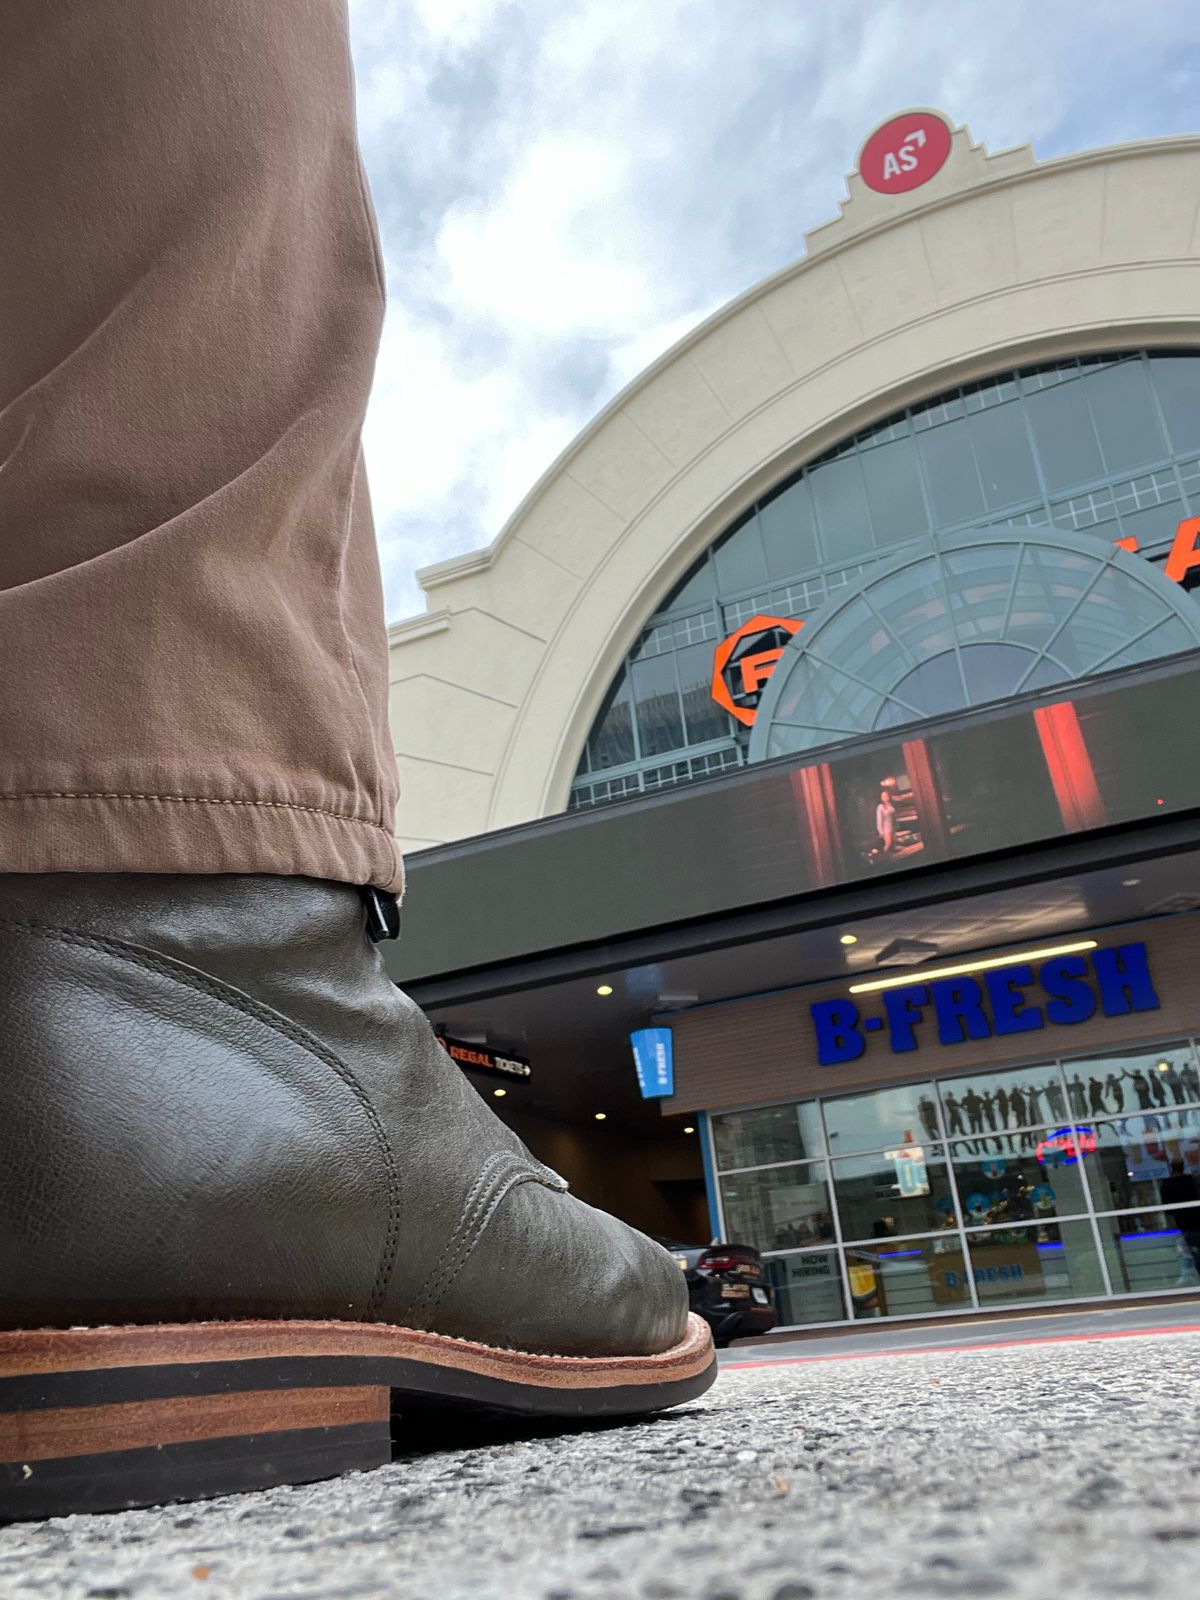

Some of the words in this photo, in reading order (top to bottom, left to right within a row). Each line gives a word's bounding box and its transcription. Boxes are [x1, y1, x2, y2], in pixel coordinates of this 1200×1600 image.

[883, 145, 918, 180] AS
[810, 942, 1161, 1066] B-FRESH
[450, 1046, 493, 1068] REGAL
[801, 1255, 828, 1265] NOW
[792, 1265, 830, 1278] HIRING
